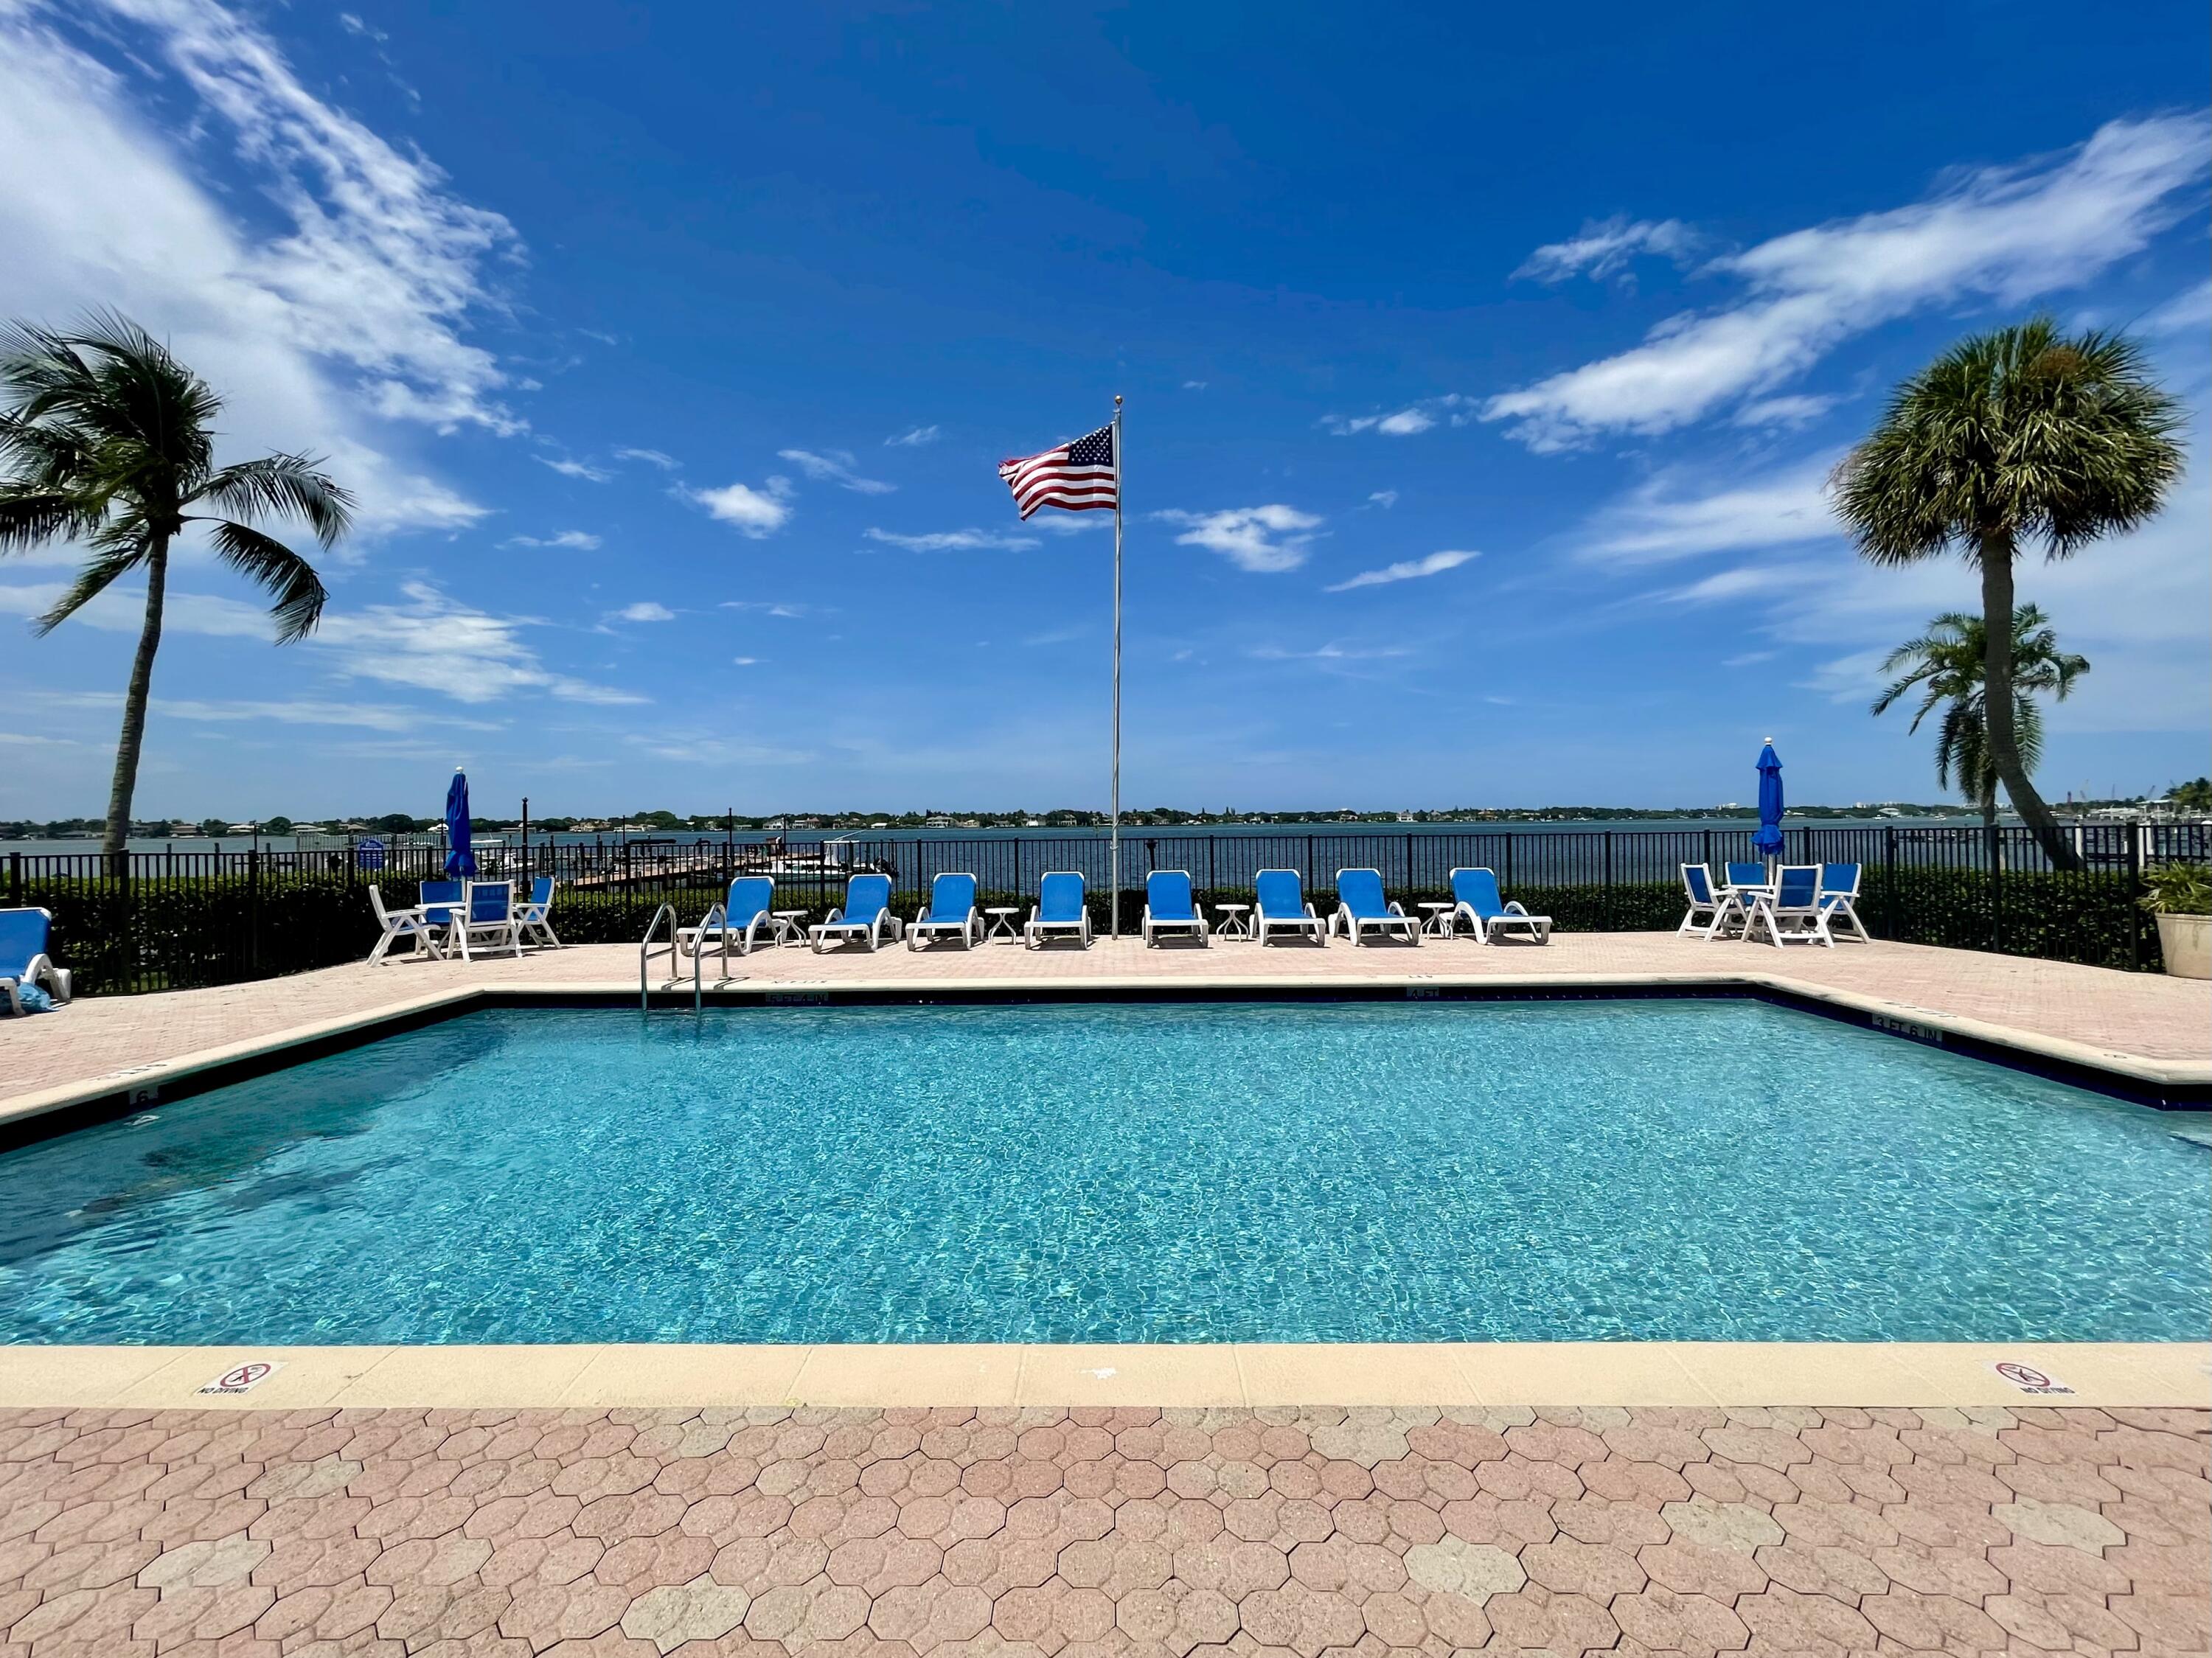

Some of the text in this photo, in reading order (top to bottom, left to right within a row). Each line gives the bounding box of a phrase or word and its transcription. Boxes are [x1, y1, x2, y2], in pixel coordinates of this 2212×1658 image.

[1425, 989, 1437, 997] FT
[1890, 1019, 1904, 1032] FT
[1910, 1025, 1919, 1037] 6
[1924, 1028, 1937, 1041] IN
